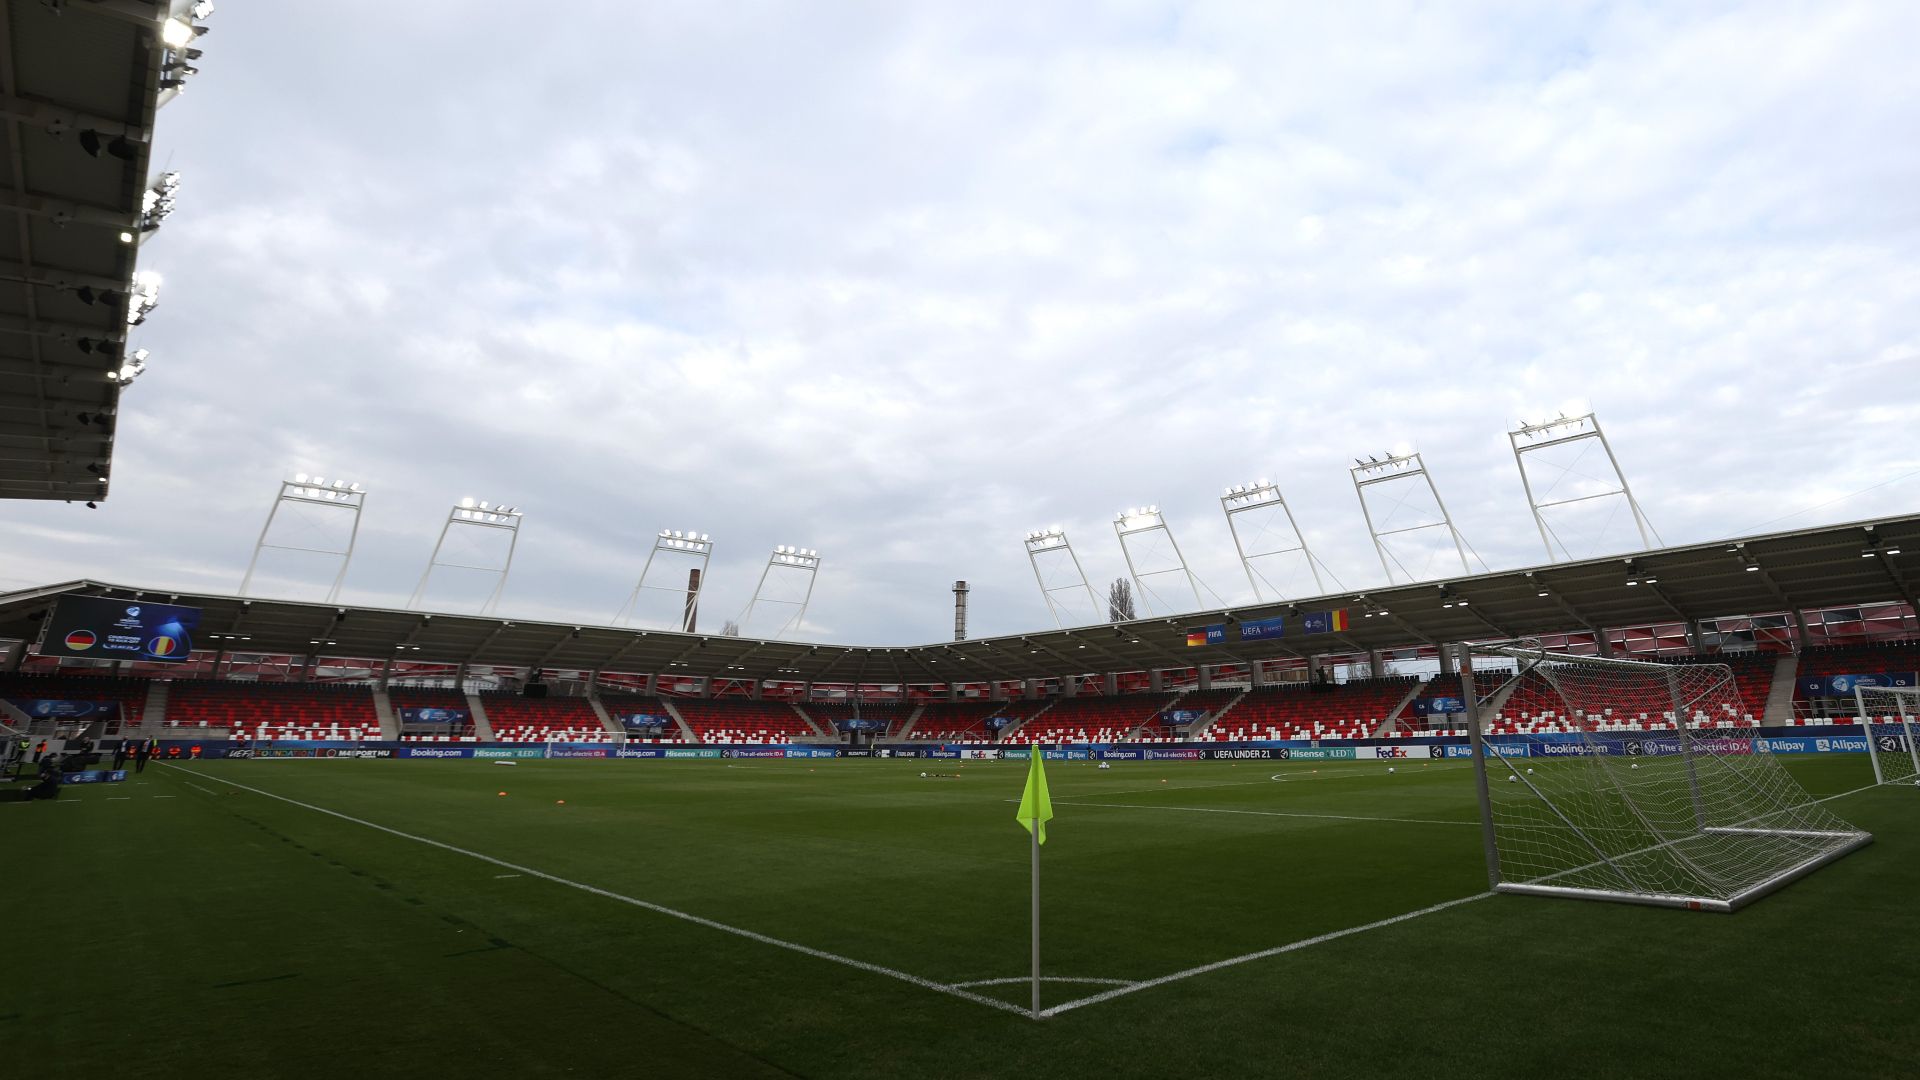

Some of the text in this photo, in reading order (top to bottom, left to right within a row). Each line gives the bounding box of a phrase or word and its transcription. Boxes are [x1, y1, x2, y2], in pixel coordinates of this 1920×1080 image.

[1208, 630, 1222, 638] FIFA
[1243, 626, 1261, 635] UEFA
[1544, 744, 1608, 755] Booking.com
[1729, 742, 1749, 751] ID.4
[1772, 741, 1804, 751] Alipay
[1832, 740, 1867, 751] Alipay
[1214, 750, 1270, 759] UEFA UNDER 21
[1376, 747, 1407, 758] FedEx
[1458, 748, 1472, 757] Alip
[1500, 747, 1524, 757] Alipay
